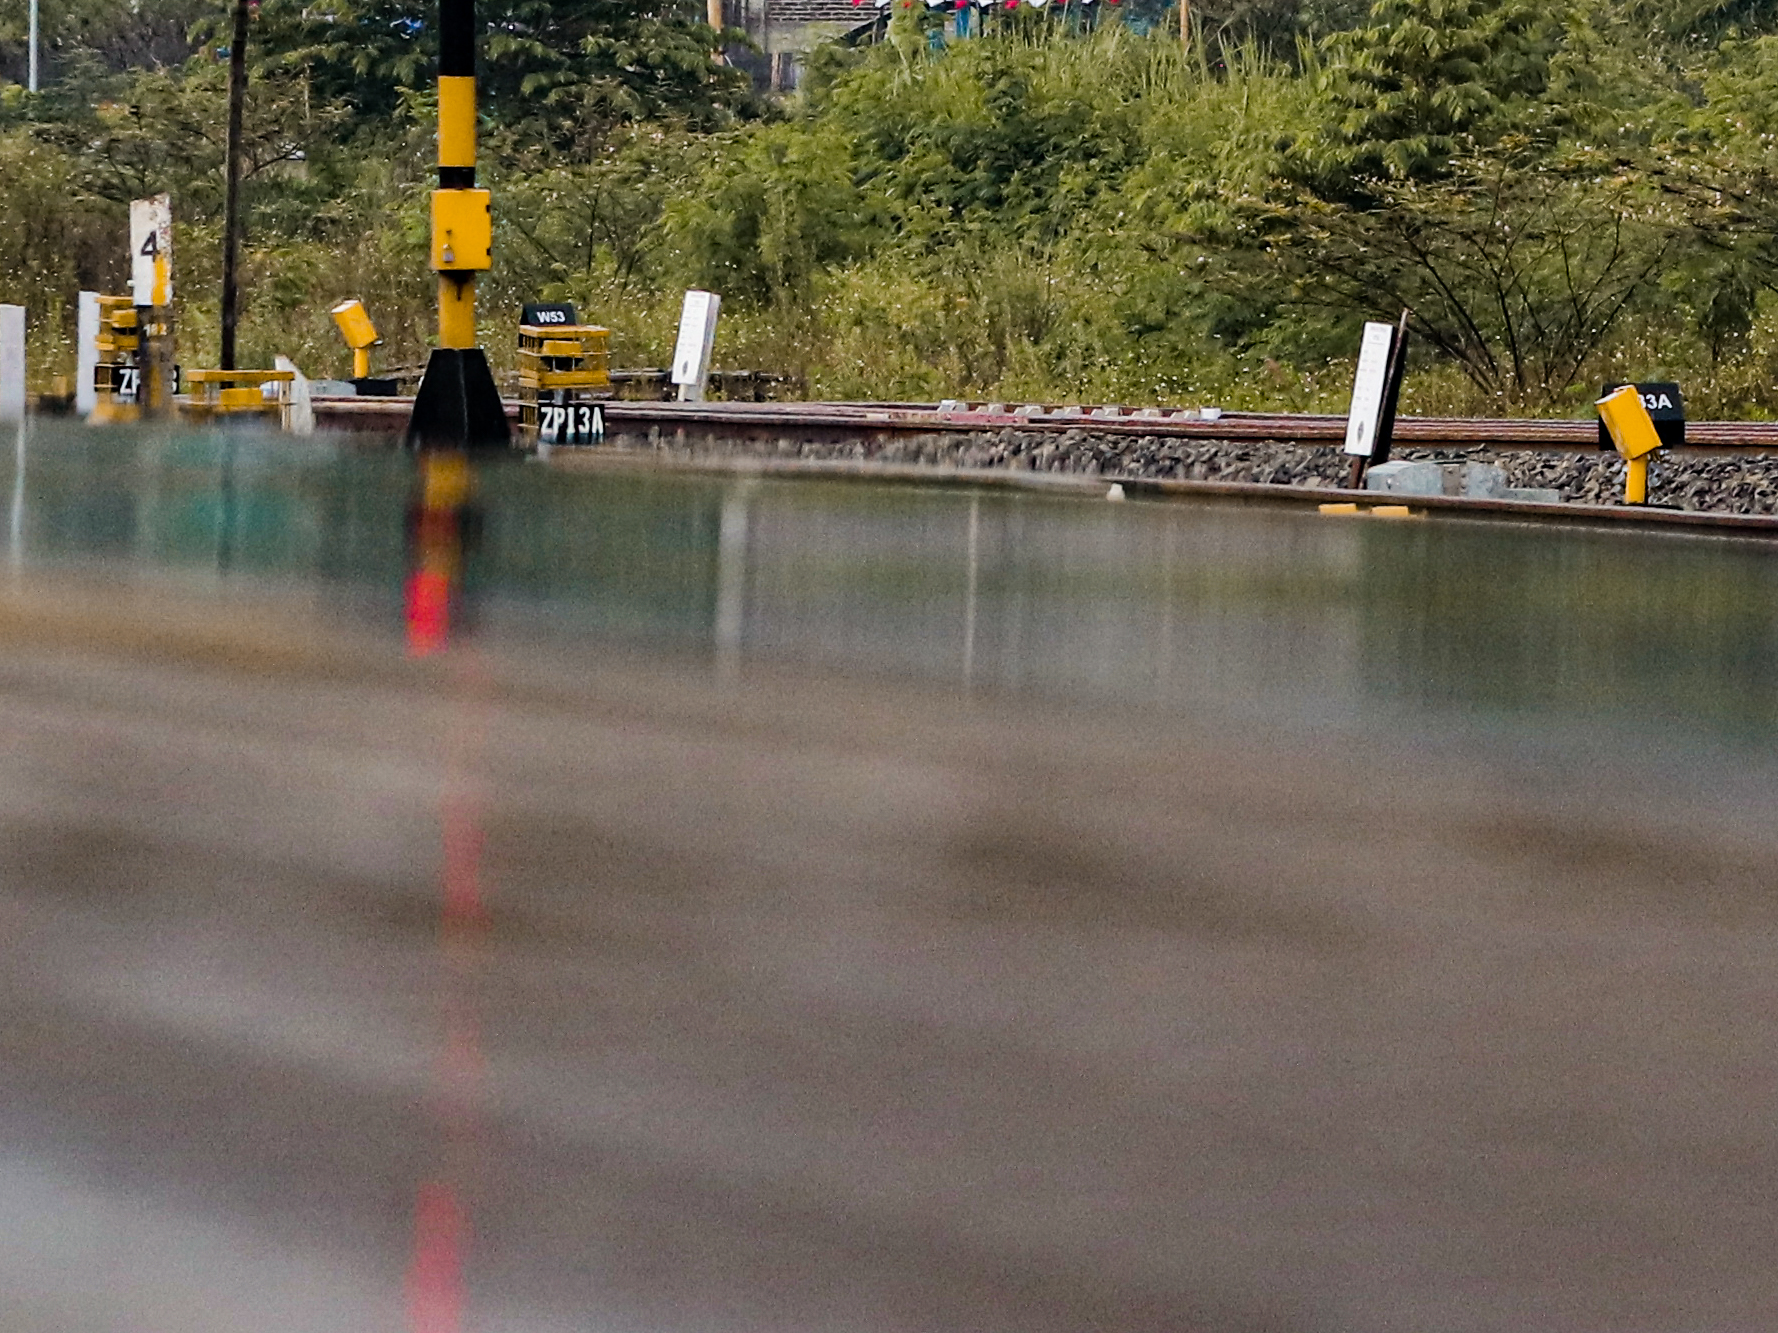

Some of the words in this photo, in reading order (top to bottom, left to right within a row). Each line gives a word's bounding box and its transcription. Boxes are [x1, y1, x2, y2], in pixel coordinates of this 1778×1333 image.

[140, 230, 160, 263] 4
[536, 310, 566, 324] W53
[540, 406, 604, 437] ZP13A
